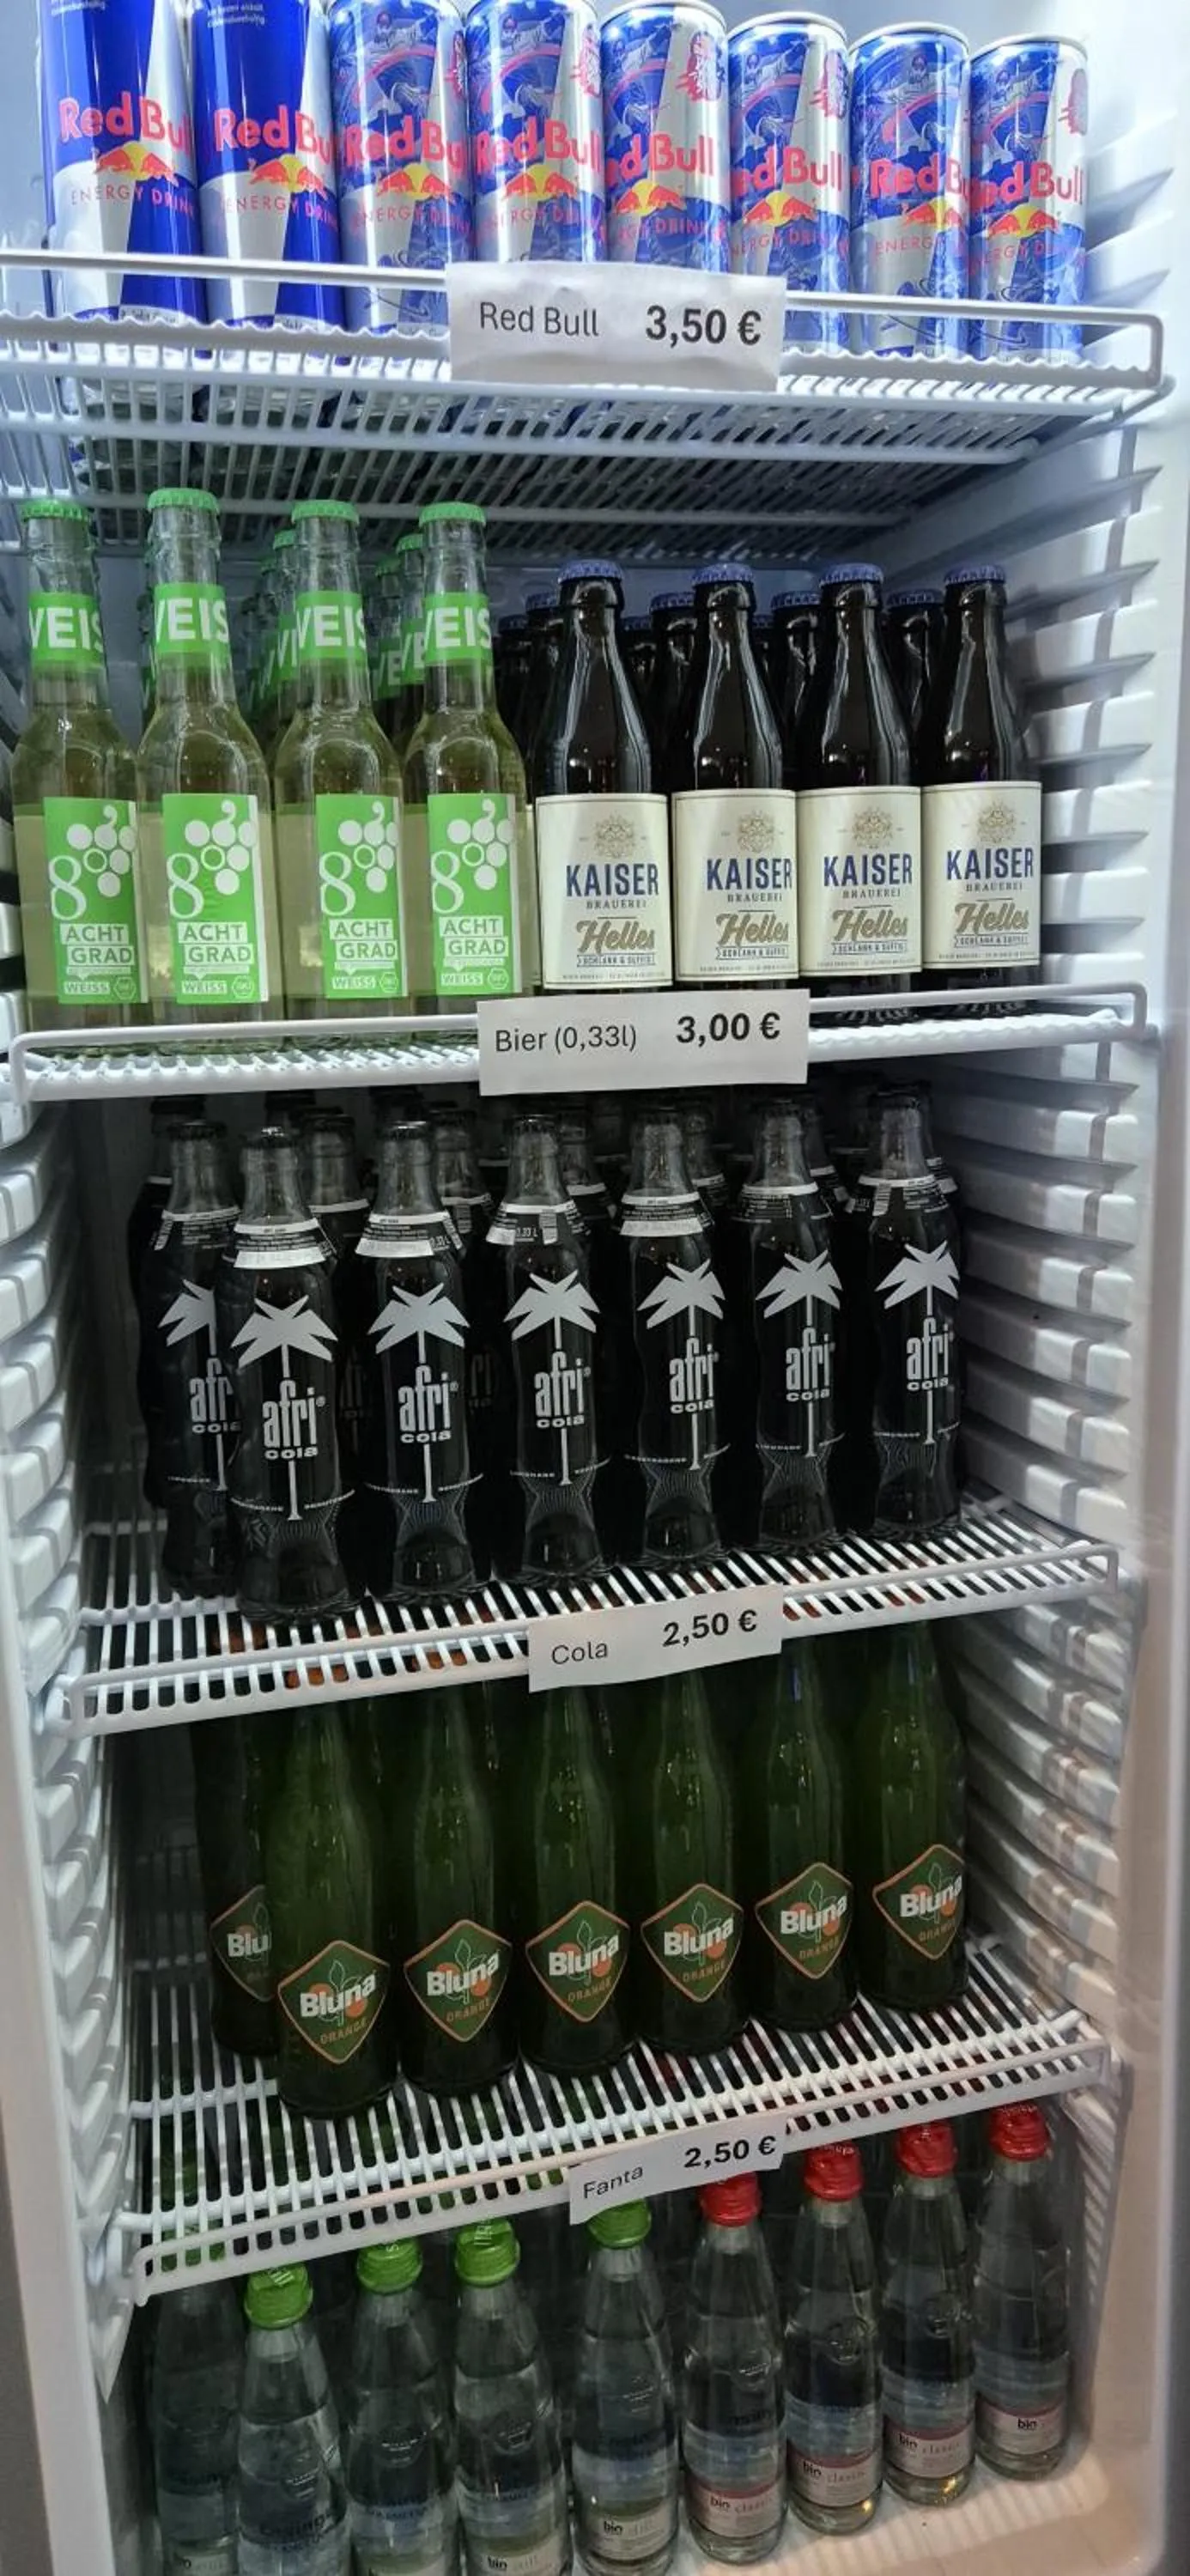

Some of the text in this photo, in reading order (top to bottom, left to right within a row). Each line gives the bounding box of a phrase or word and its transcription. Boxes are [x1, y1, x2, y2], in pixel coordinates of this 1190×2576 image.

[58, 91, 134, 142] Red
[215, 105, 336, 166] Red Bu
[345, 115, 465, 172] Red Bu
[476, 116, 537, 173] Red
[605, 132, 714, 187] ed Bull
[732, 143, 842, 198] ed Bull
[870, 153, 939, 199] Red
[1030, 161, 1084, 205] Bull
[480, 301, 762, 348] Red Bull 3,50 €
[566, 863, 659, 897] KAISER
[707, 858, 792, 890] KAISER
[823, 854, 913, 887] KAISER
[947, 848, 1034, 880] KAISER
[727, 891, 783, 903] BRAUEREI
[842, 889, 902, 900] BRAUEREI
[966, 883, 1023, 893] BRAUEREI
[586, 899, 647, 910] BRAUEREI
[954, 902, 1029, 934] Helles
[65, 925, 128, 942] ACHT
[183, 924, 244, 941] ACHT
[333, 921, 391, 938] ACHT
[442, 918, 500, 935] ACHT
[576, 920, 655, 954] Helles
[715, 914, 789, 947] Helles
[832, 909, 908, 941] Helles
[70, 946, 133, 963] GRAD
[188, 946, 252, 963] GRAD
[339, 942, 397, 959] GRAD
[448, 939, 506, 956] GRAD
[495, 1012, 780, 1054] Bier (0,33l) 3,00 €
[786, 1327, 830, 1390] afri
[907, 1317, 949, 1380] afri
[534, 1351, 585, 1418] afri
[669, 1337, 714, 1402] afri
[907, 1377, 949, 1391] cola
[190, 1358, 234, 1423] afr
[398, 1365, 452, 1432] afri
[671, 1399, 714, 1414] cola
[786, 1388, 830, 1402] cola
[263, 1380, 318, 1449] afri
[537, 1415, 585, 1429] cola
[400, 1430, 452, 1443] cola
[264, 1446, 319, 1460] cola
[551, 1609, 757, 1665] Cola 2,50 €
[901, 1875, 962, 1917] Bluna
[780, 1896, 847, 1935] Bluna
[227, 1932, 269, 1958] Blu
[664, 1917, 734, 1957] Bluna
[549, 1934, 619, 1976] Bluna
[427, 1953, 500, 1996] Bluna
[682, 1960, 726, 1983] ORANGE
[300, 1972, 377, 2018] Bluna
[567, 1978, 612, 2002] ORANGE
[446, 1998, 490, 2022] ORANGE
[319, 2017, 369, 2045] ORANGE
[583, 2136, 776, 2199] Fanta 2,50 €
[899, 2433, 918, 2449] bio
[803, 2460, 822, 2477] bio
[710, 2495, 731, 2509] bio
[604, 2519, 623, 2535] bio
